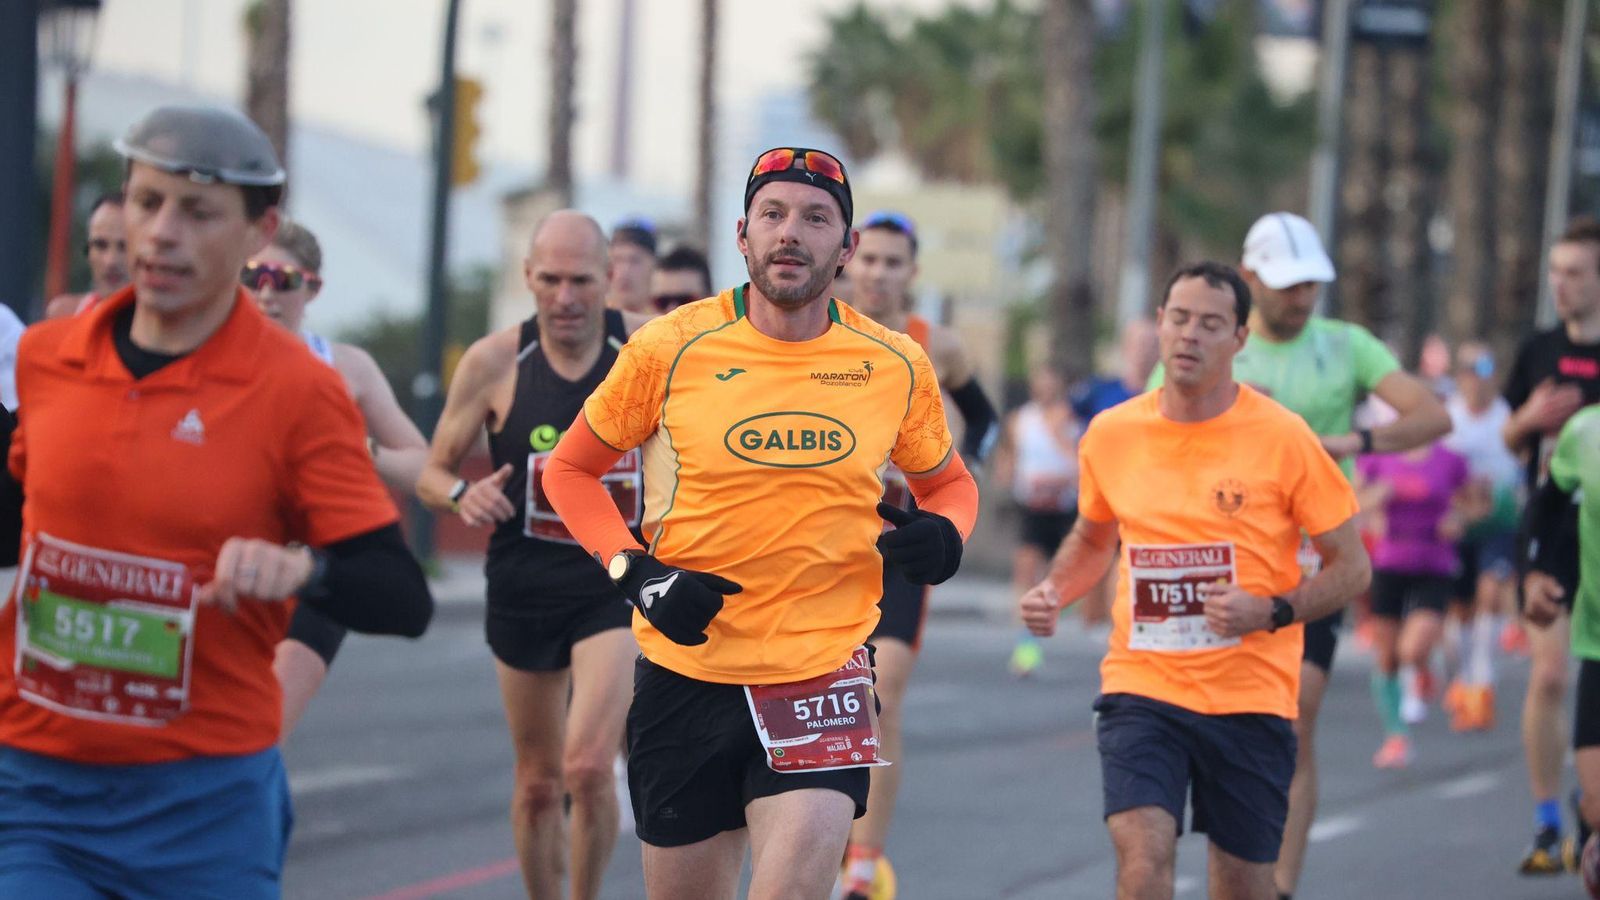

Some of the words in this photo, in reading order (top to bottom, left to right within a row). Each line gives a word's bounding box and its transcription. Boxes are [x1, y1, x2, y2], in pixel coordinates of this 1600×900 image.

[810, 372, 868, 381] MARATON
[739, 429, 842, 451] GALBIS
[1150, 548, 1225, 566] GENERALI
[60, 551, 184, 599] GENERALI
[54, 604, 141, 648] 5517
[793, 691, 861, 721] 5716
[806, 716, 857, 730] PALOMERO
